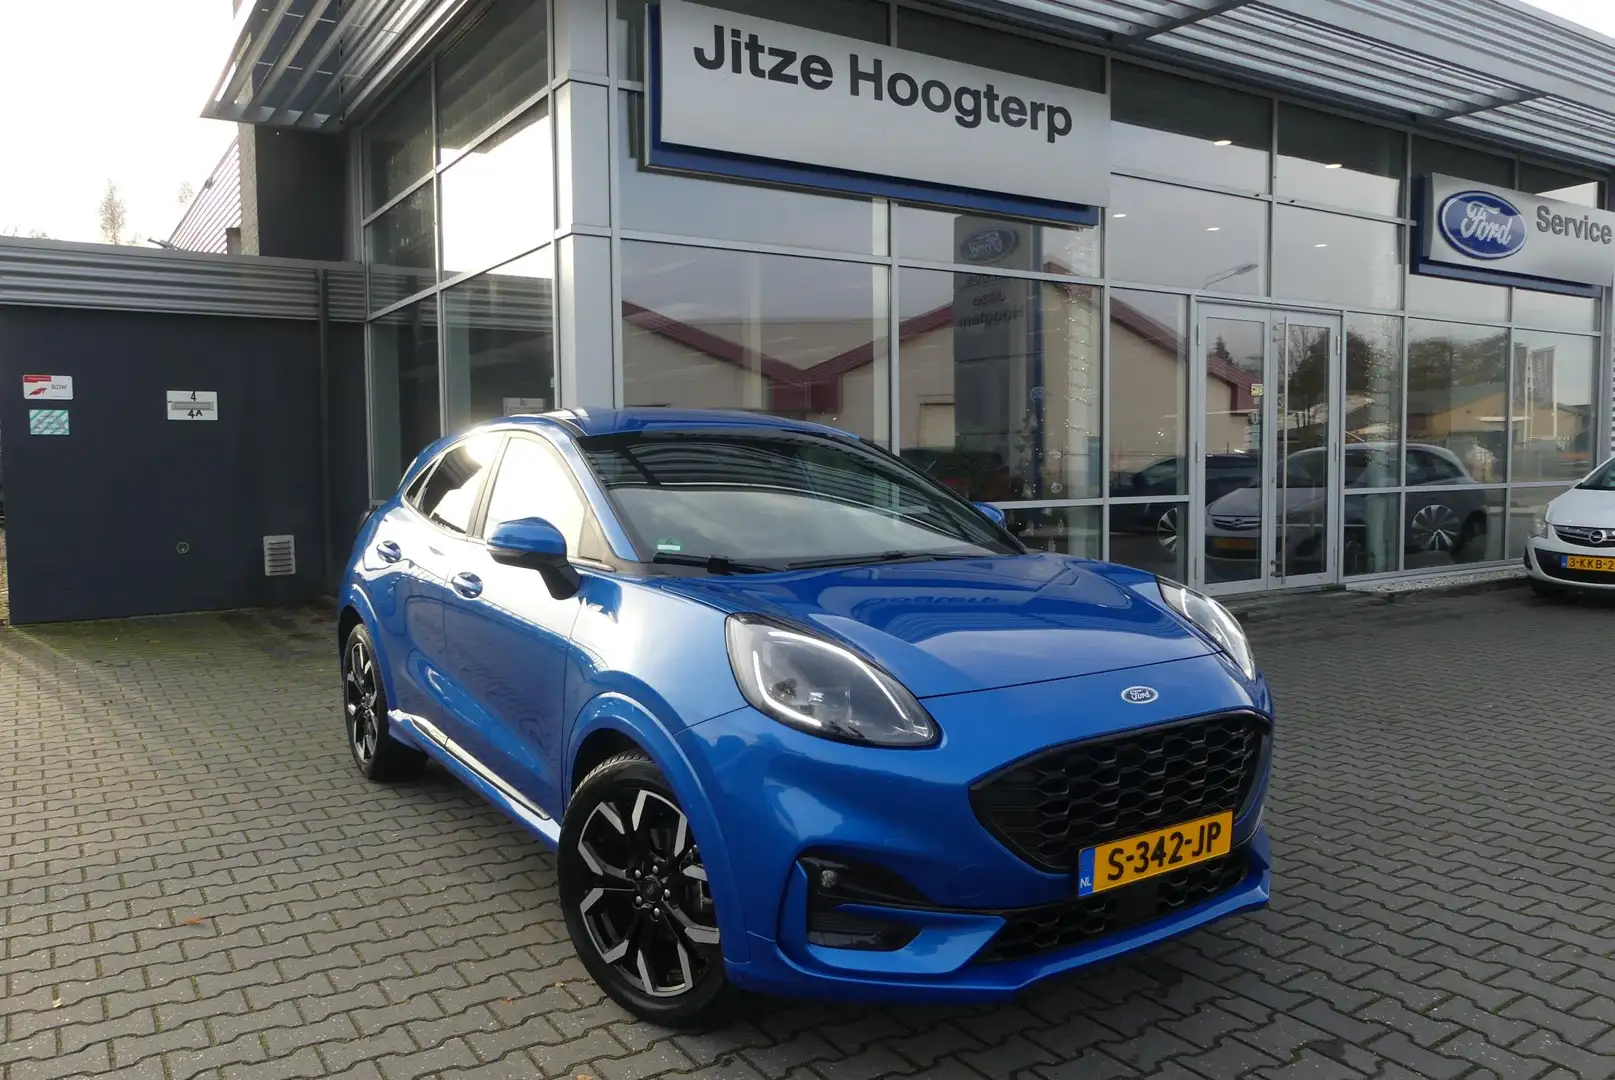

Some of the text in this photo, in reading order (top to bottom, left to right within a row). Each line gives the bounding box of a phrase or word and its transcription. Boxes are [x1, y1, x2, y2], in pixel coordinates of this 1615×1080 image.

[693, 24, 1073, 143] Jitze Hoogterp
[1460, 200, 1513, 246] Ford
[1536, 205, 1613, 245] Service
[190, 391, 197, 402] 4
[187, 408, 203, 419] 4A
[1569, 557, 1614, 570] 3-KKB-2
[1130, 689, 1151, 701] Ford
[1107, 821, 1222, 881] S-342-JP
[1080, 876, 1092, 889] NL
